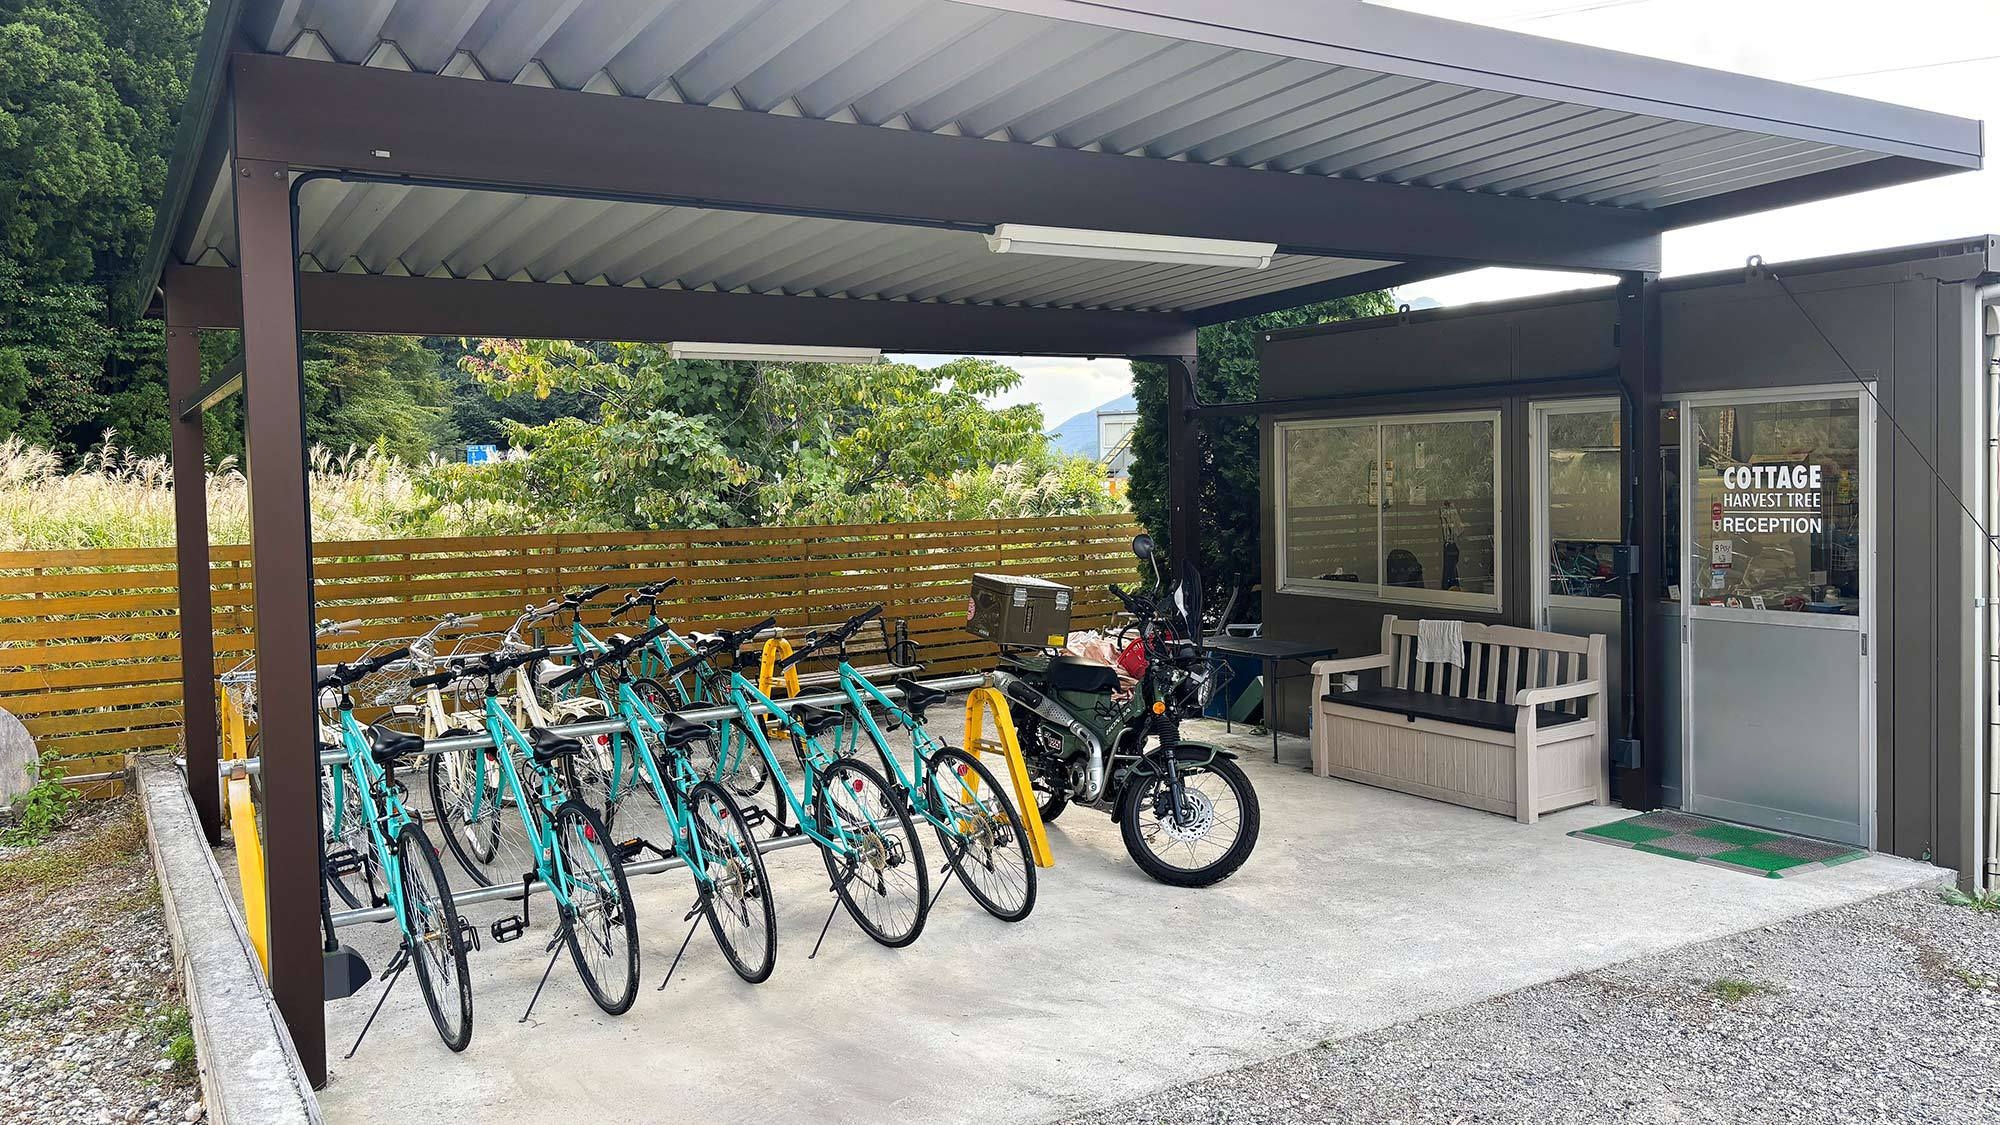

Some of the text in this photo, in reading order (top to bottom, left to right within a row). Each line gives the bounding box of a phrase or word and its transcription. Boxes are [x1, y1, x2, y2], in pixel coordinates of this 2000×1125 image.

[1723, 464, 1821, 490] COTTAGE
[1723, 492, 1821, 508] HARVEST TREE
[1723, 517, 1822, 534] RECEPTION
